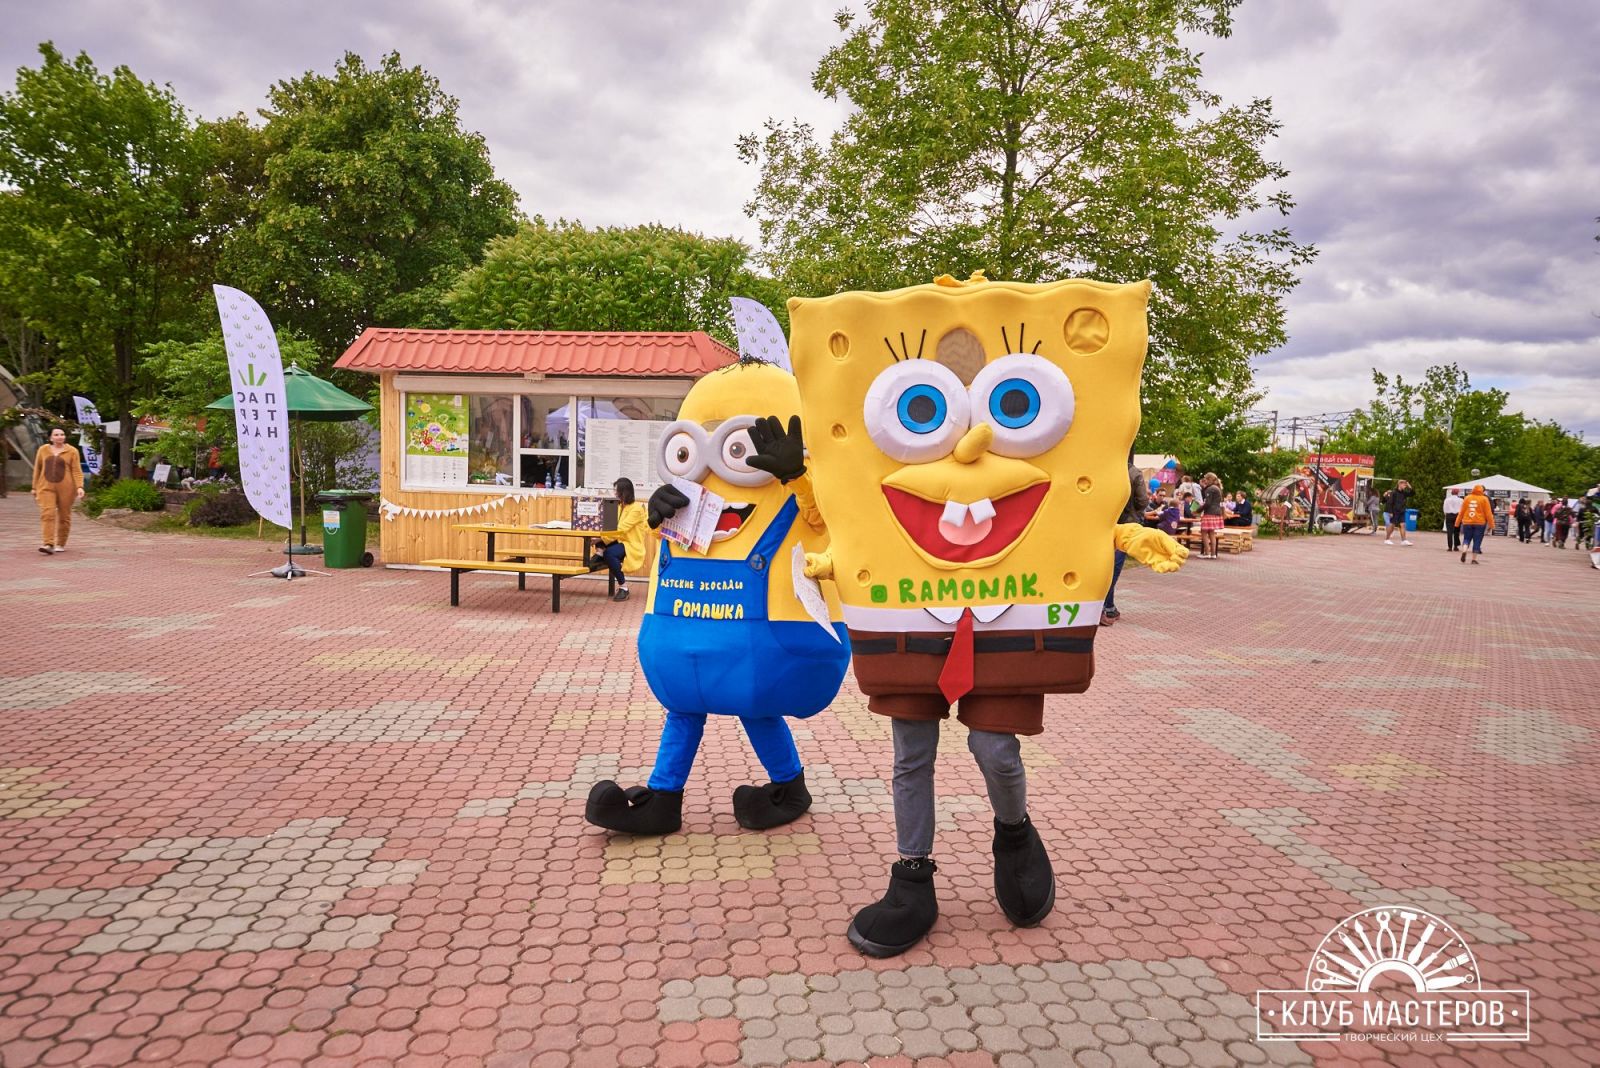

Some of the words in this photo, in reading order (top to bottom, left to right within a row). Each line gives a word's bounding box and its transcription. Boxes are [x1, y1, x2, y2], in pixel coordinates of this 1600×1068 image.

[660, 579, 694, 589] ДЕТСКИЕ
[673, 598, 744, 620] РОМАШКА
[1047, 604, 1080, 625] BY
